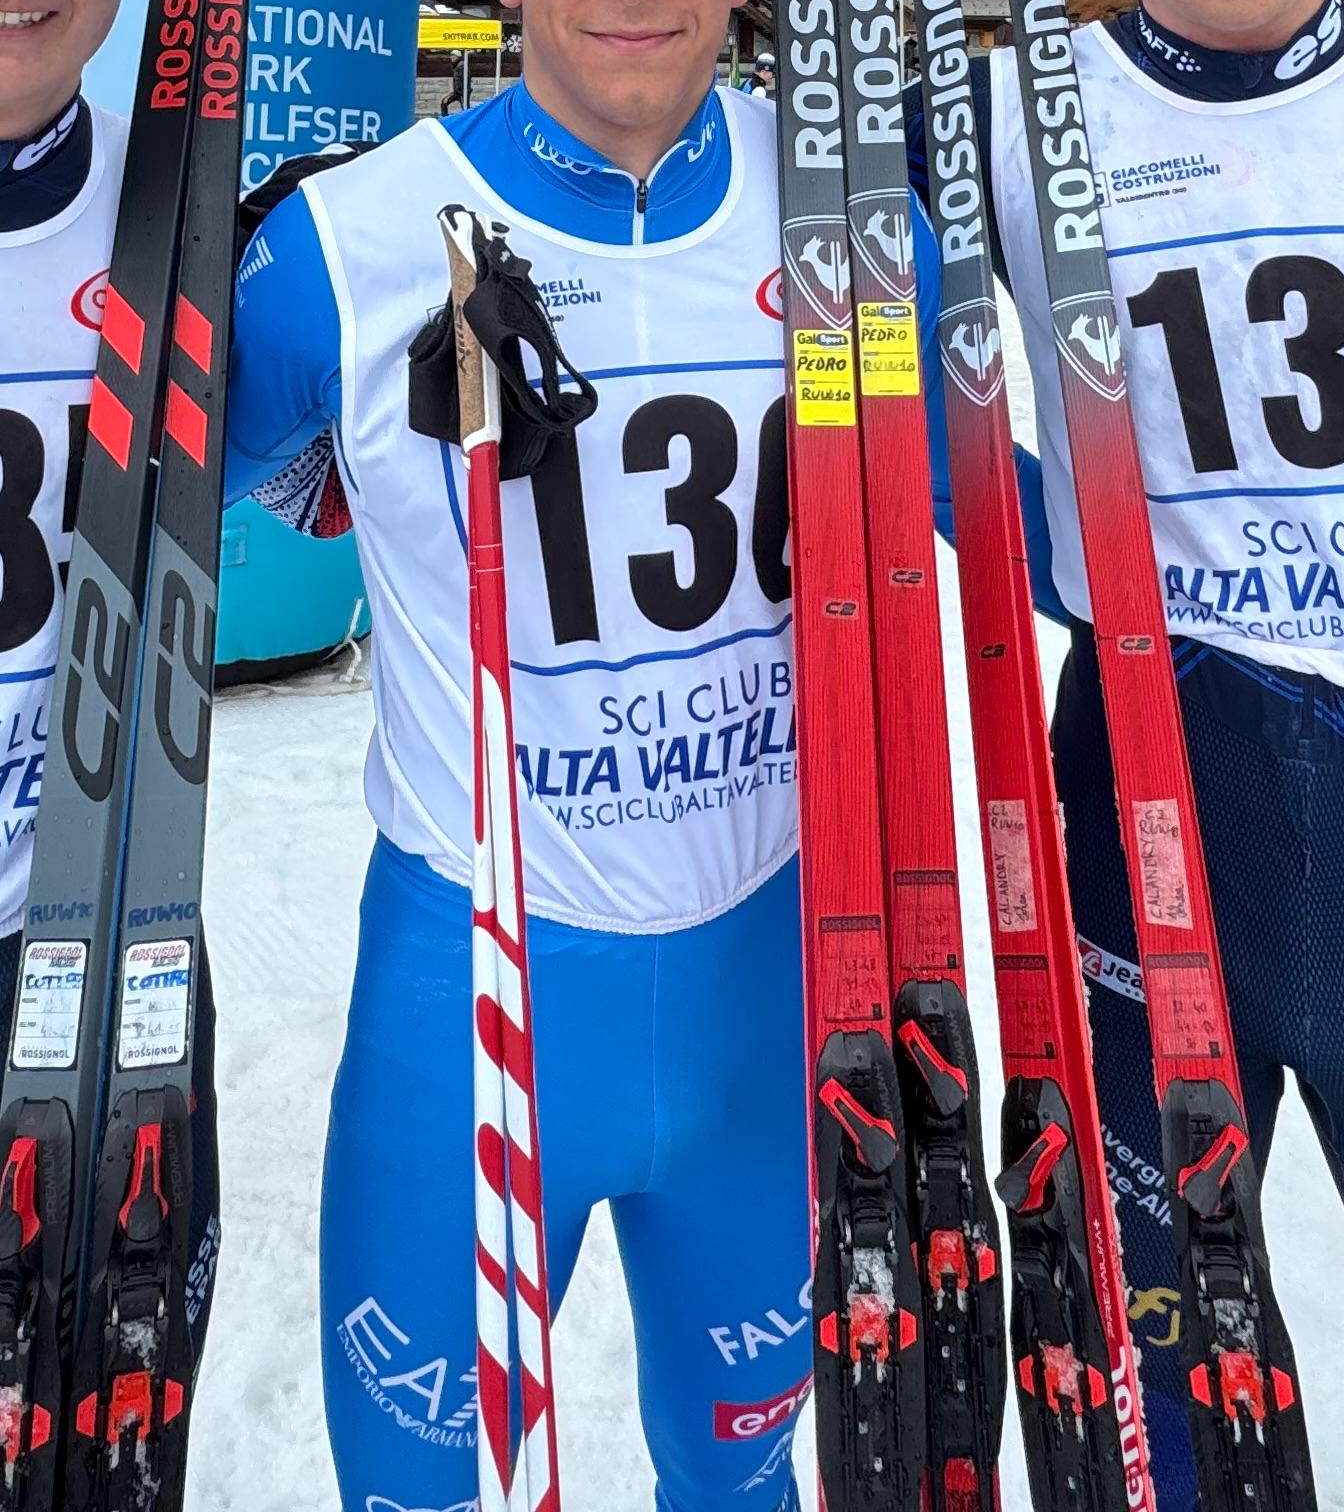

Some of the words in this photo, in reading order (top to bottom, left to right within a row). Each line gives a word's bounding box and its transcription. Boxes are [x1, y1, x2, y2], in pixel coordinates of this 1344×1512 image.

[251, 6, 393, 57] TIONAL
[250, 54, 312, 95] RK
[245, 104, 383, 144] ILFSER
[1110, 154, 1205, 181] GIACOMELLI
[1112, 164, 1222, 192] COSTRUZIONI
[860, 327, 907, 343] PEDRO
[796, 355, 847, 372] PEDRO
[1242, 519, 1318, 557] SCI
[1164, 563, 1271, 614] ALTA
[599, 689, 667, 737] SCI
[686, 661, 791, 723] CLUB
[514, 742, 623, 801] ALTA
